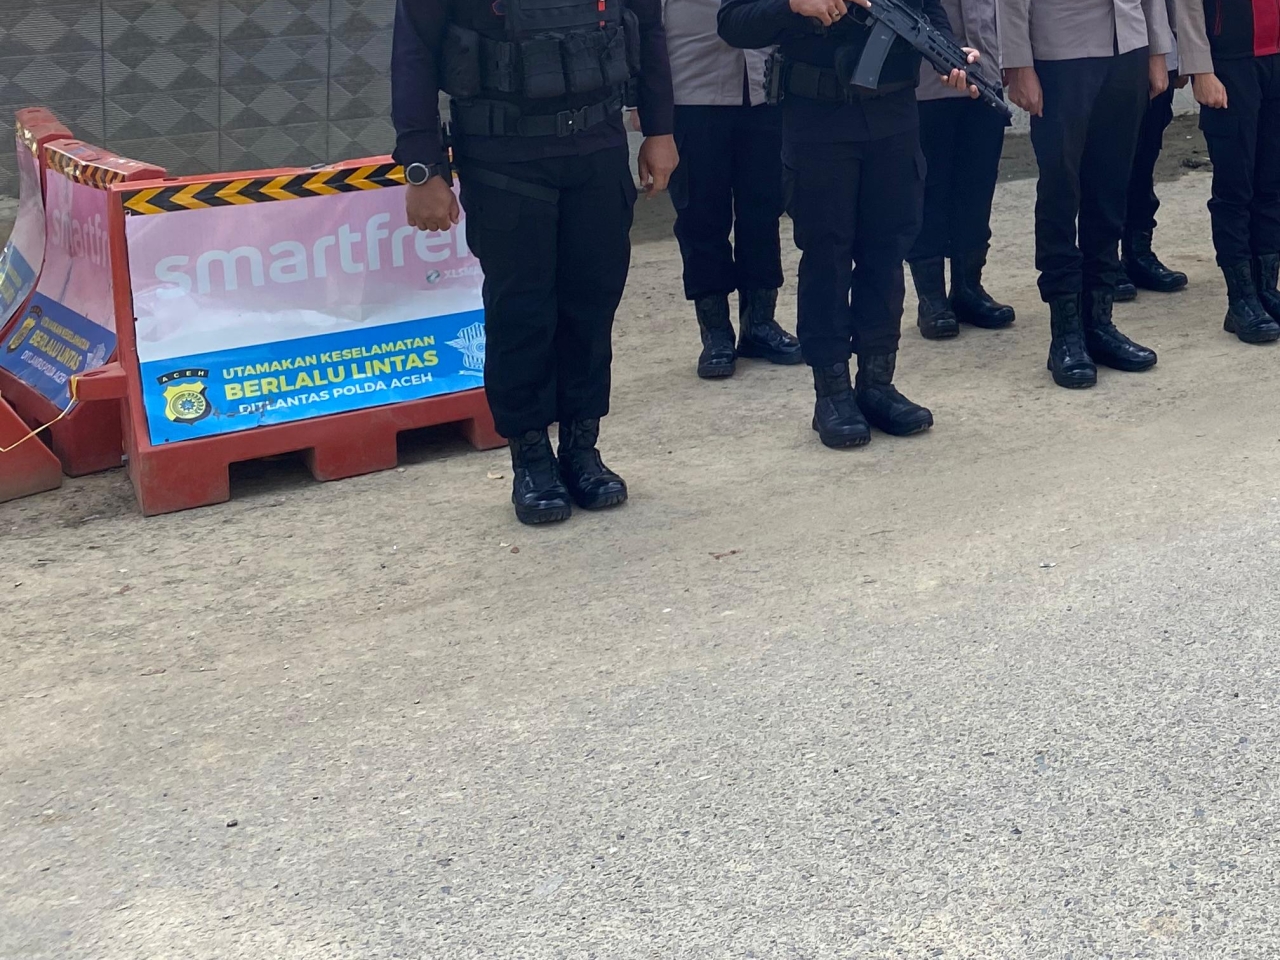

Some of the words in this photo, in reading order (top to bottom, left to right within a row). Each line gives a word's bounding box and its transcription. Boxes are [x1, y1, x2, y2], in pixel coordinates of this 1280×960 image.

[55, 346, 82, 370] LINTAS
[162, 370, 205, 382] ACEH
[222, 354, 317, 380] UTAMAKAN
[320, 335, 435, 364] KESELAMATAN
[224, 365, 346, 401] BERLALU
[351, 350, 439, 380] LINTAS
[238, 391, 330, 415] DITLANTAS
[333, 381, 387, 399] POLDA
[390, 372, 433, 389] ACEH
